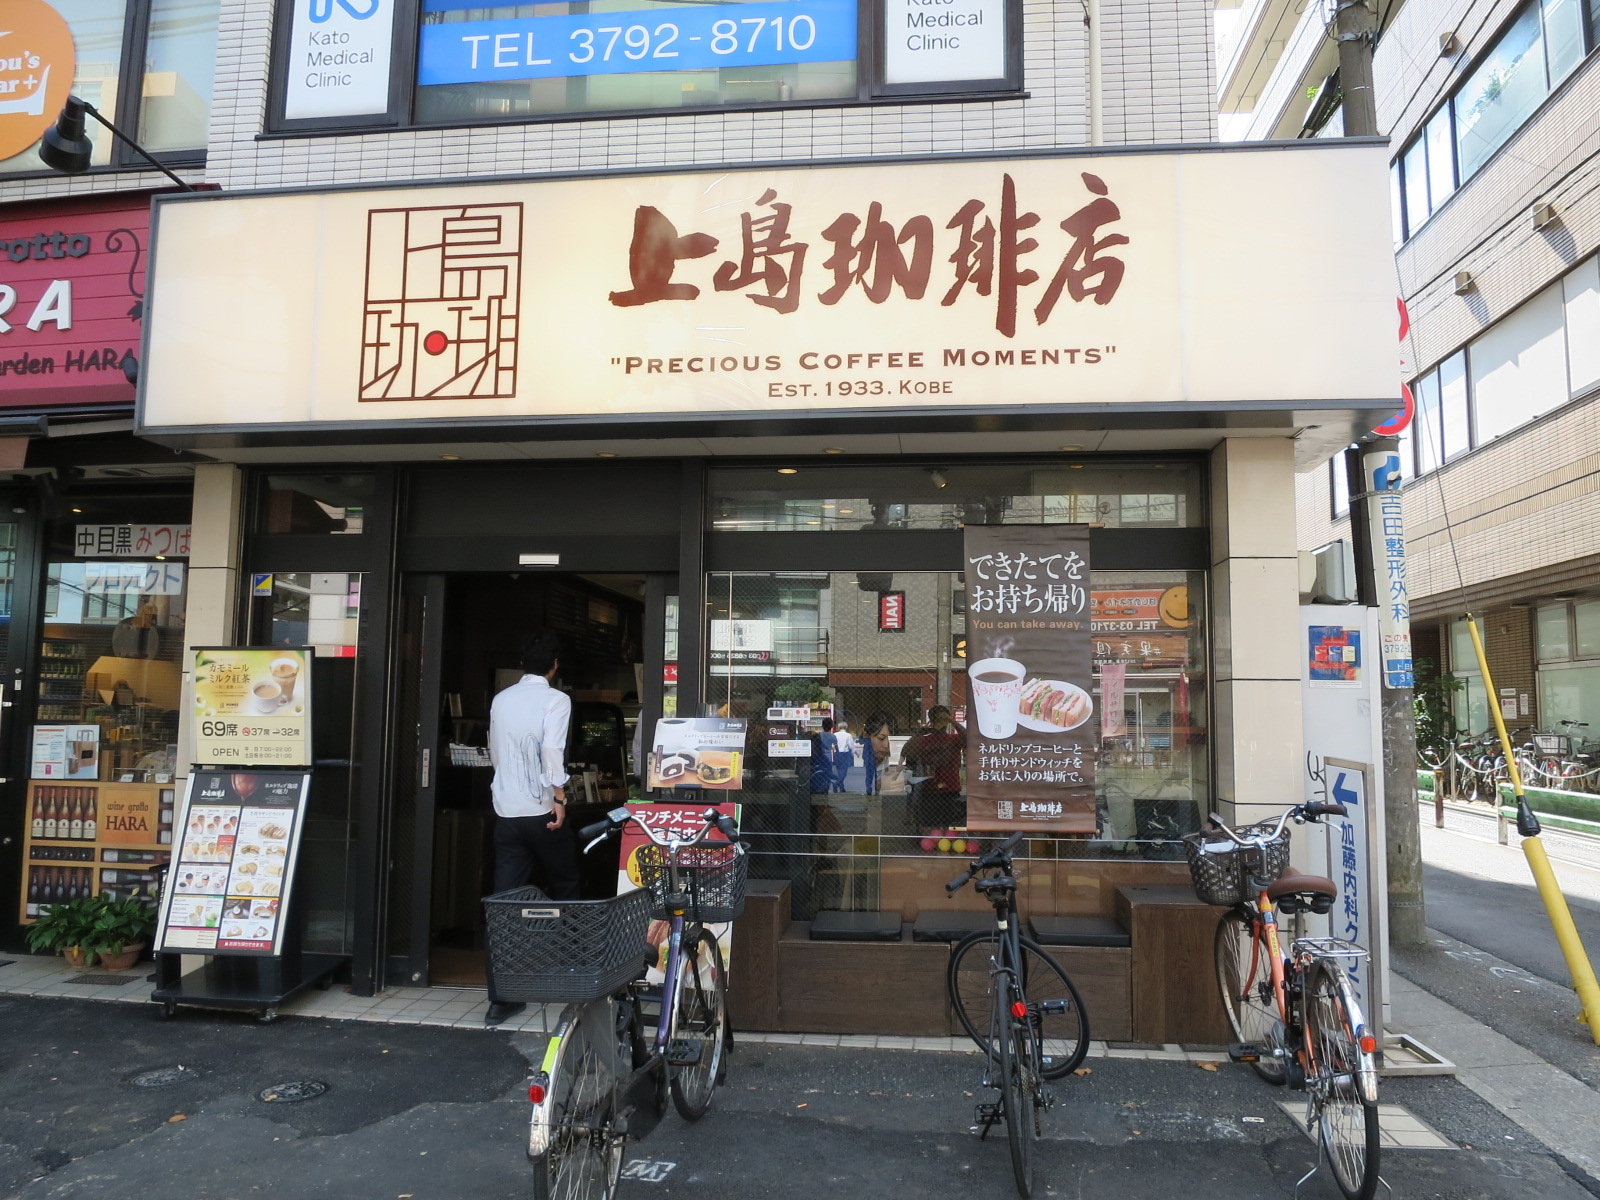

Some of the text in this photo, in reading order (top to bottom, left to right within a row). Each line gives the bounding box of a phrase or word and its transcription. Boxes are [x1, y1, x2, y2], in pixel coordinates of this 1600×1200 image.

[906, 9, 983, 28] Medical
[308, 30, 350, 46] Kato
[906, 33, 960, 50] Clinic
[307, 48, 373, 67] Medical
[461, 32, 552, 68] TEL
[305, 71, 352, 88] Clinic
[0, 231, 92, 262] otto
[609, 172, 1131, 336] 上島珈琲店
[969, 551, 1085, 581] できたてを
[970, 583, 1086, 614] お持ち帰り
[972, 619, 1084, 631] You can take away.
[210, 663, 250, 673] カモミール
[210, 674, 250, 684] ミルク紅茶
[202, 721, 238, 737] 69席
[212, 748, 240, 757] OPEN
[978, 743, 1082, 755] ネルドリップコーヒーと
[978, 757, 1083, 769] 手作りサンドウィッチを
[978, 770, 1084, 783] お気に入りの場所で。
[1019, 801, 1062, 815] 上島珈琲店
[106, 815, 149, 831] HARA
